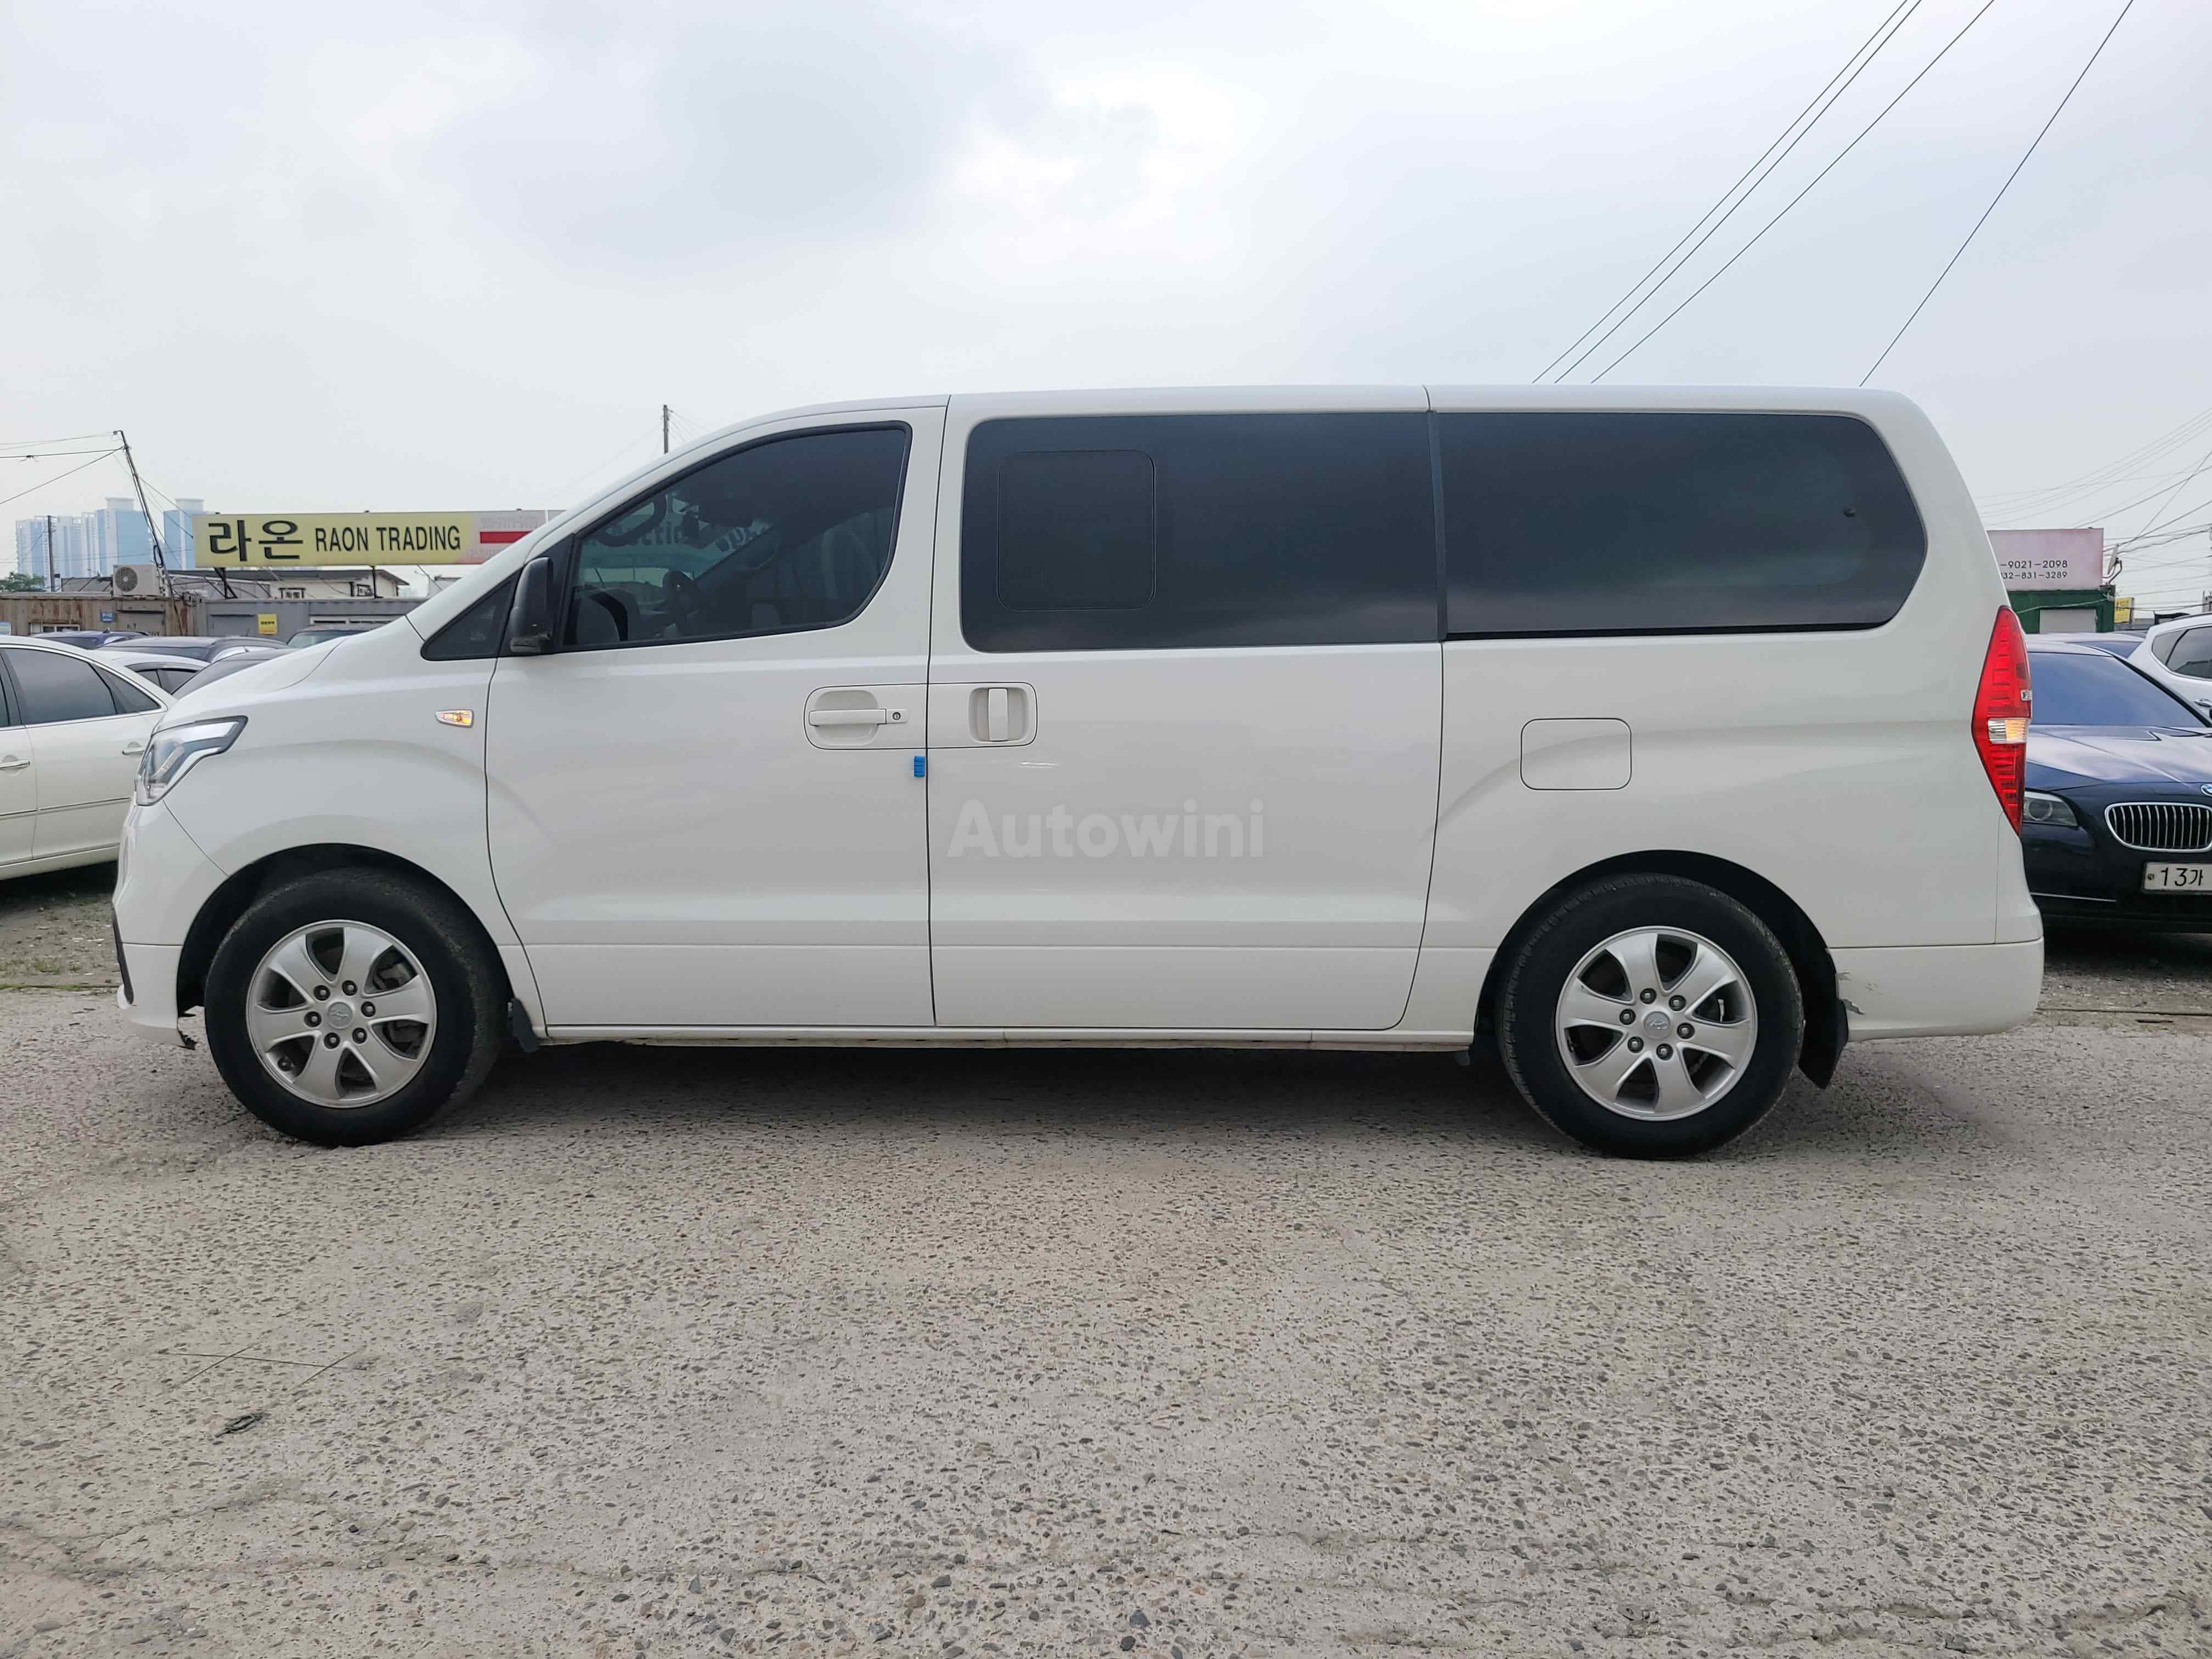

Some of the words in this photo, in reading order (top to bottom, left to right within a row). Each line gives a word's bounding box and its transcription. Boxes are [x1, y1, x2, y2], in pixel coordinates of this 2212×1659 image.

[208, 520, 303, 562] 라온
[315, 527, 369, 552] RAON
[376, 525, 461, 551] TRADING
[2001, 571, 2068, 579] 32-831-3289
[2160, 867, 2204, 887] 13가
